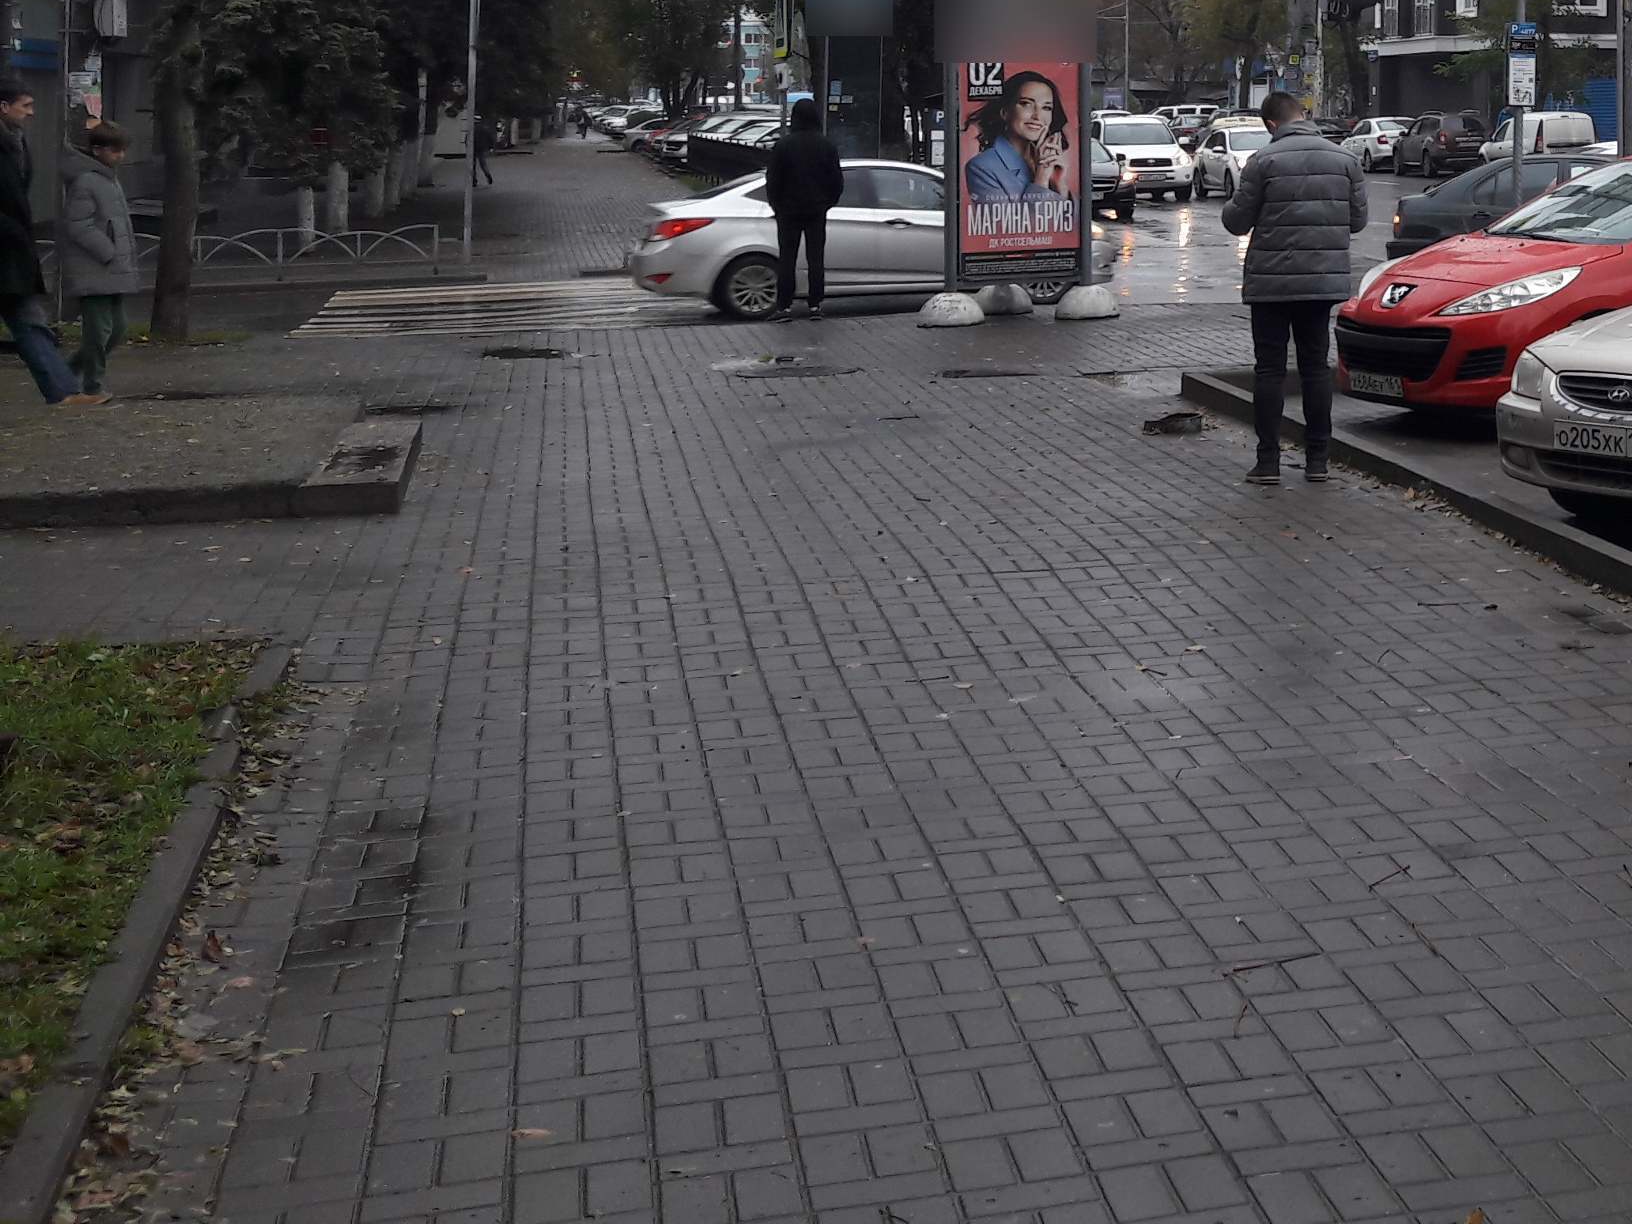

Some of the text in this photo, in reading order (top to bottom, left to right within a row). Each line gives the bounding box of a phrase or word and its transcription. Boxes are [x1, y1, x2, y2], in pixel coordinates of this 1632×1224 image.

[969, 62, 1002, 86] 02
[969, 85, 1003, 96] ДЕКАБРЯ
[967, 200, 1073, 236] МАРИНА БРИЗ
[1559, 426, 1624, 453] О205ХК
